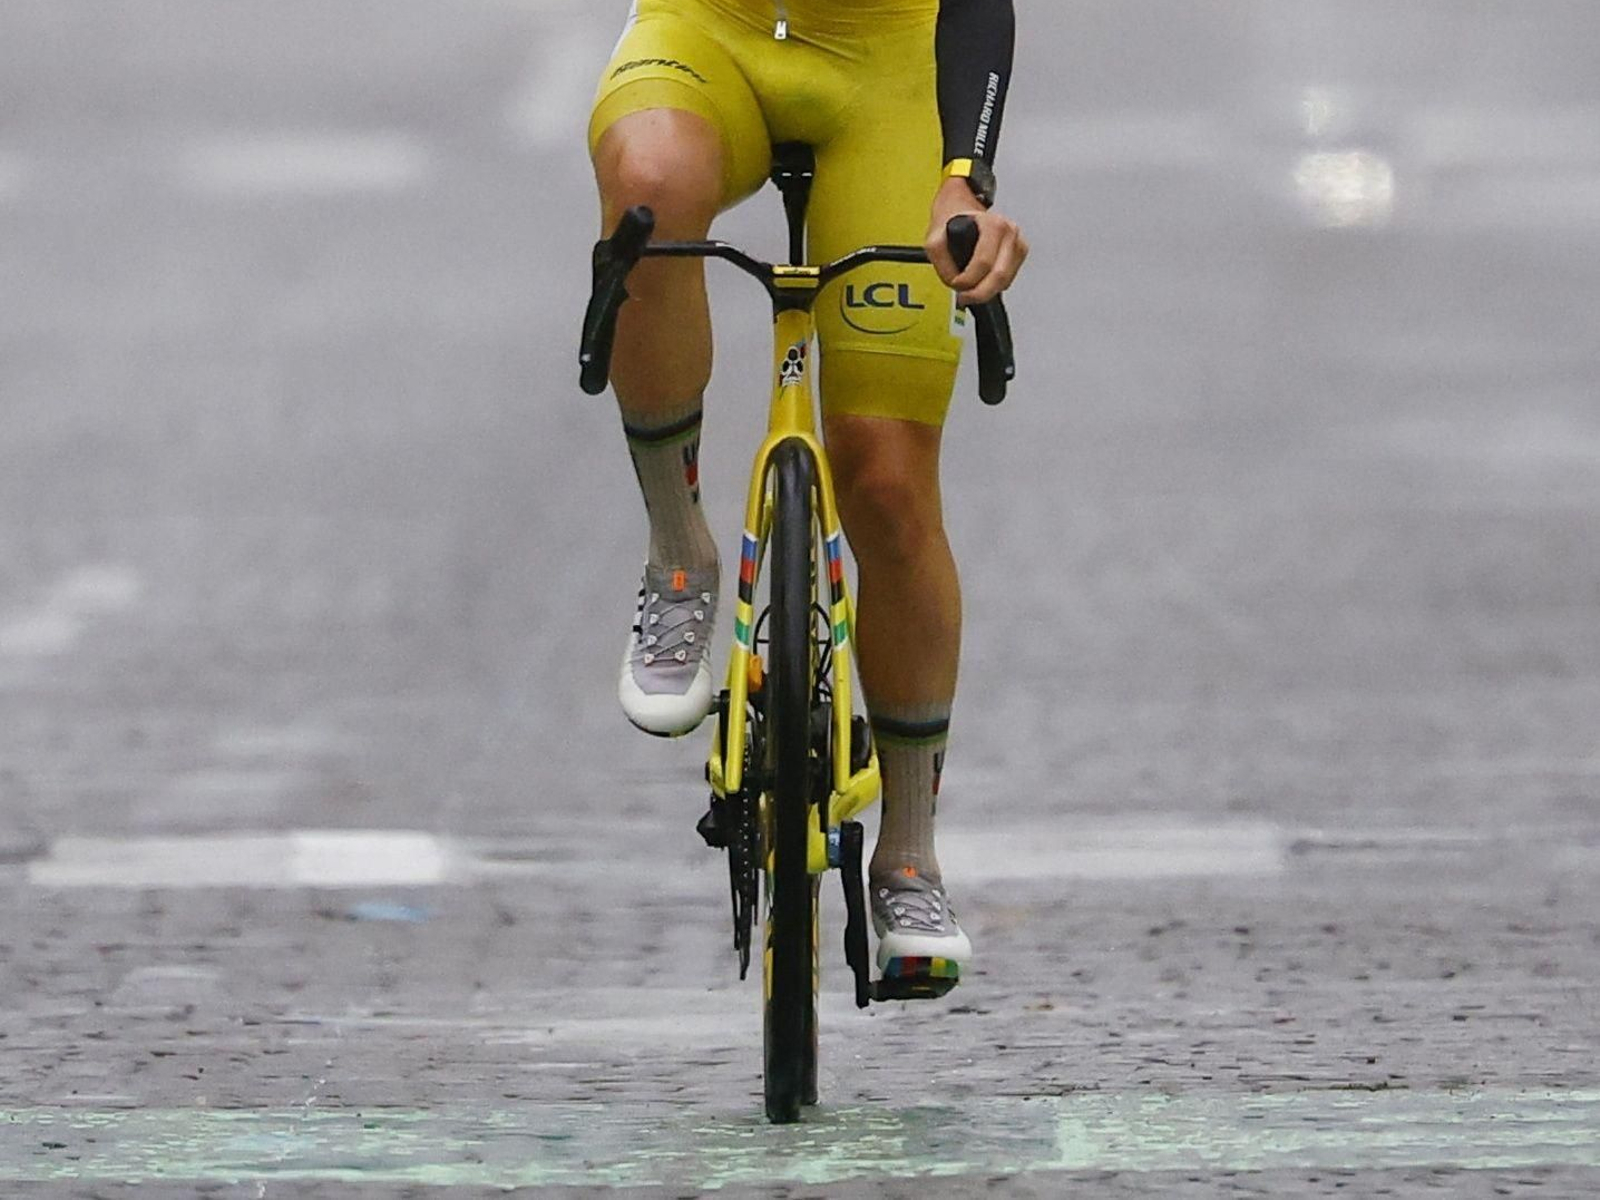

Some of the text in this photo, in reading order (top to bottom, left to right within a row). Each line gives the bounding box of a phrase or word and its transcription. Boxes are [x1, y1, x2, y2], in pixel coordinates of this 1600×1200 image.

[974, 71, 999, 156] RICHARD MILLE
[846, 282, 925, 309] LCL
